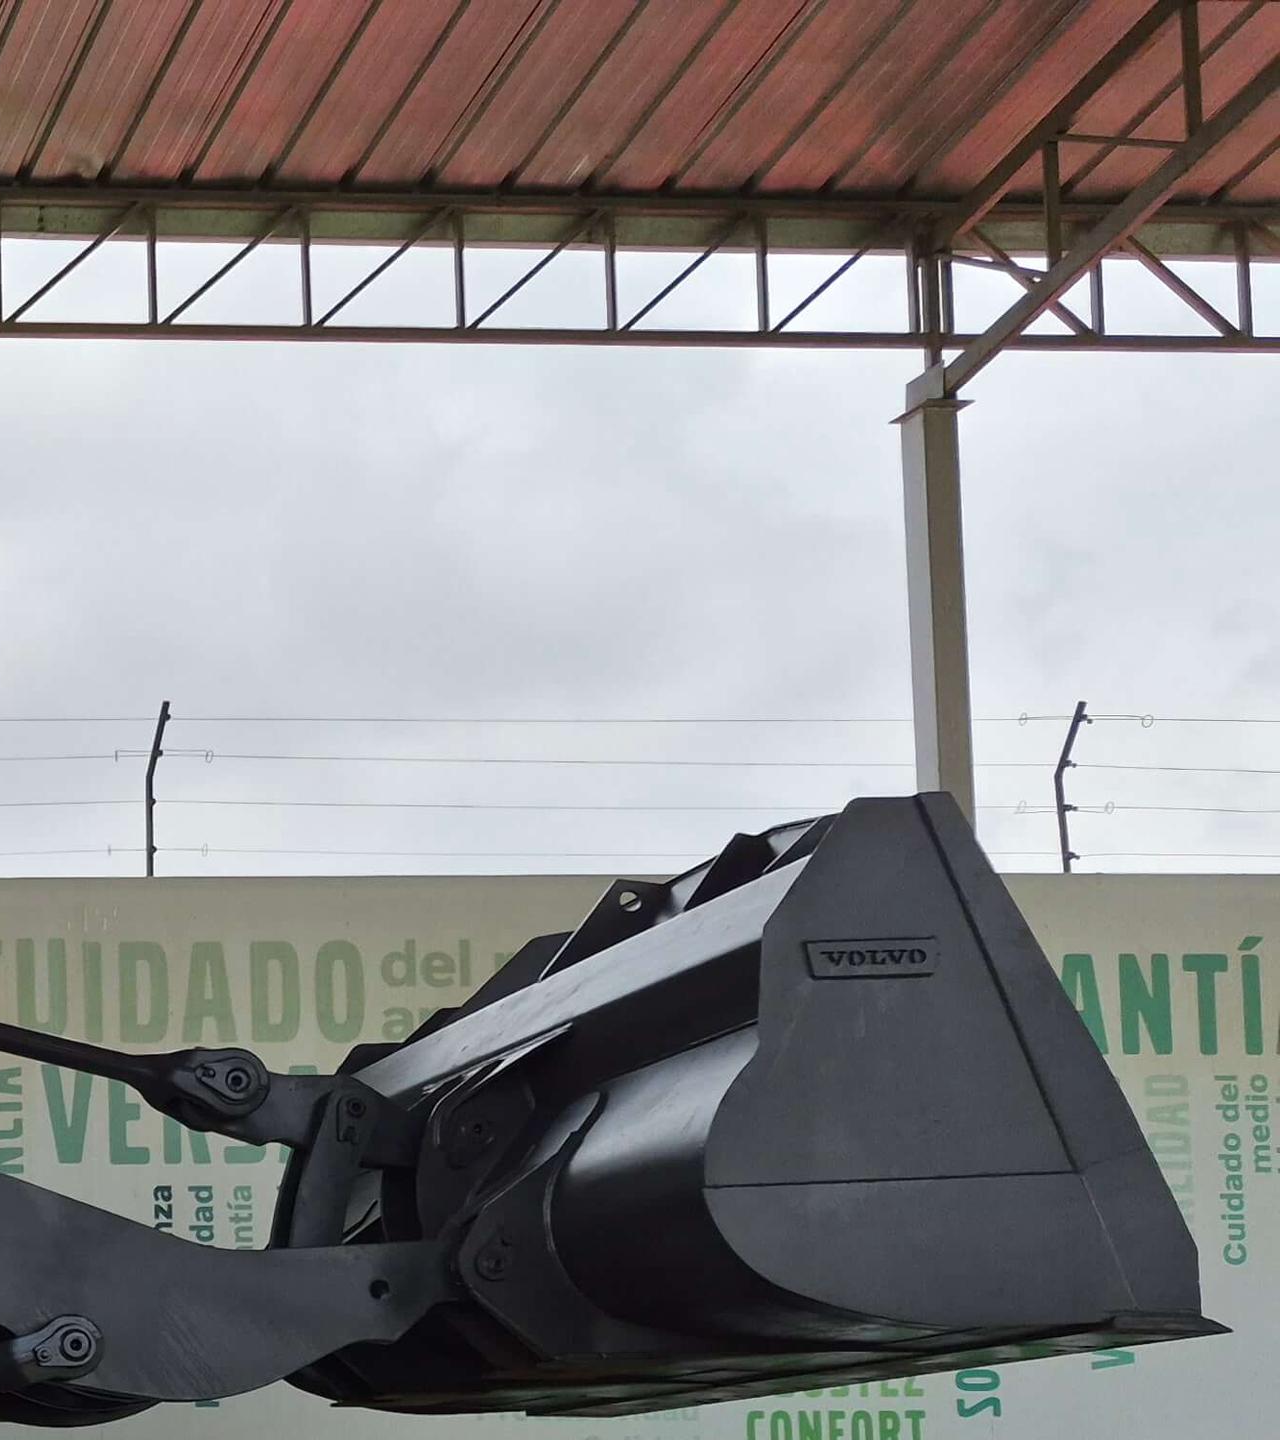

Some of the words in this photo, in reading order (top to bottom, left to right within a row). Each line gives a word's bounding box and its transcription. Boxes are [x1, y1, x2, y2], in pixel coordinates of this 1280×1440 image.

[381, 939, 471, 988] del
[819, 948, 927, 966] VOLVO
[1213, 1074, 1241, 1123] del
[1245, 1073, 1272, 1174] medio
[227, 1185, 253, 1249] ntía
[1218, 1132, 1248, 1266] Cuidado
